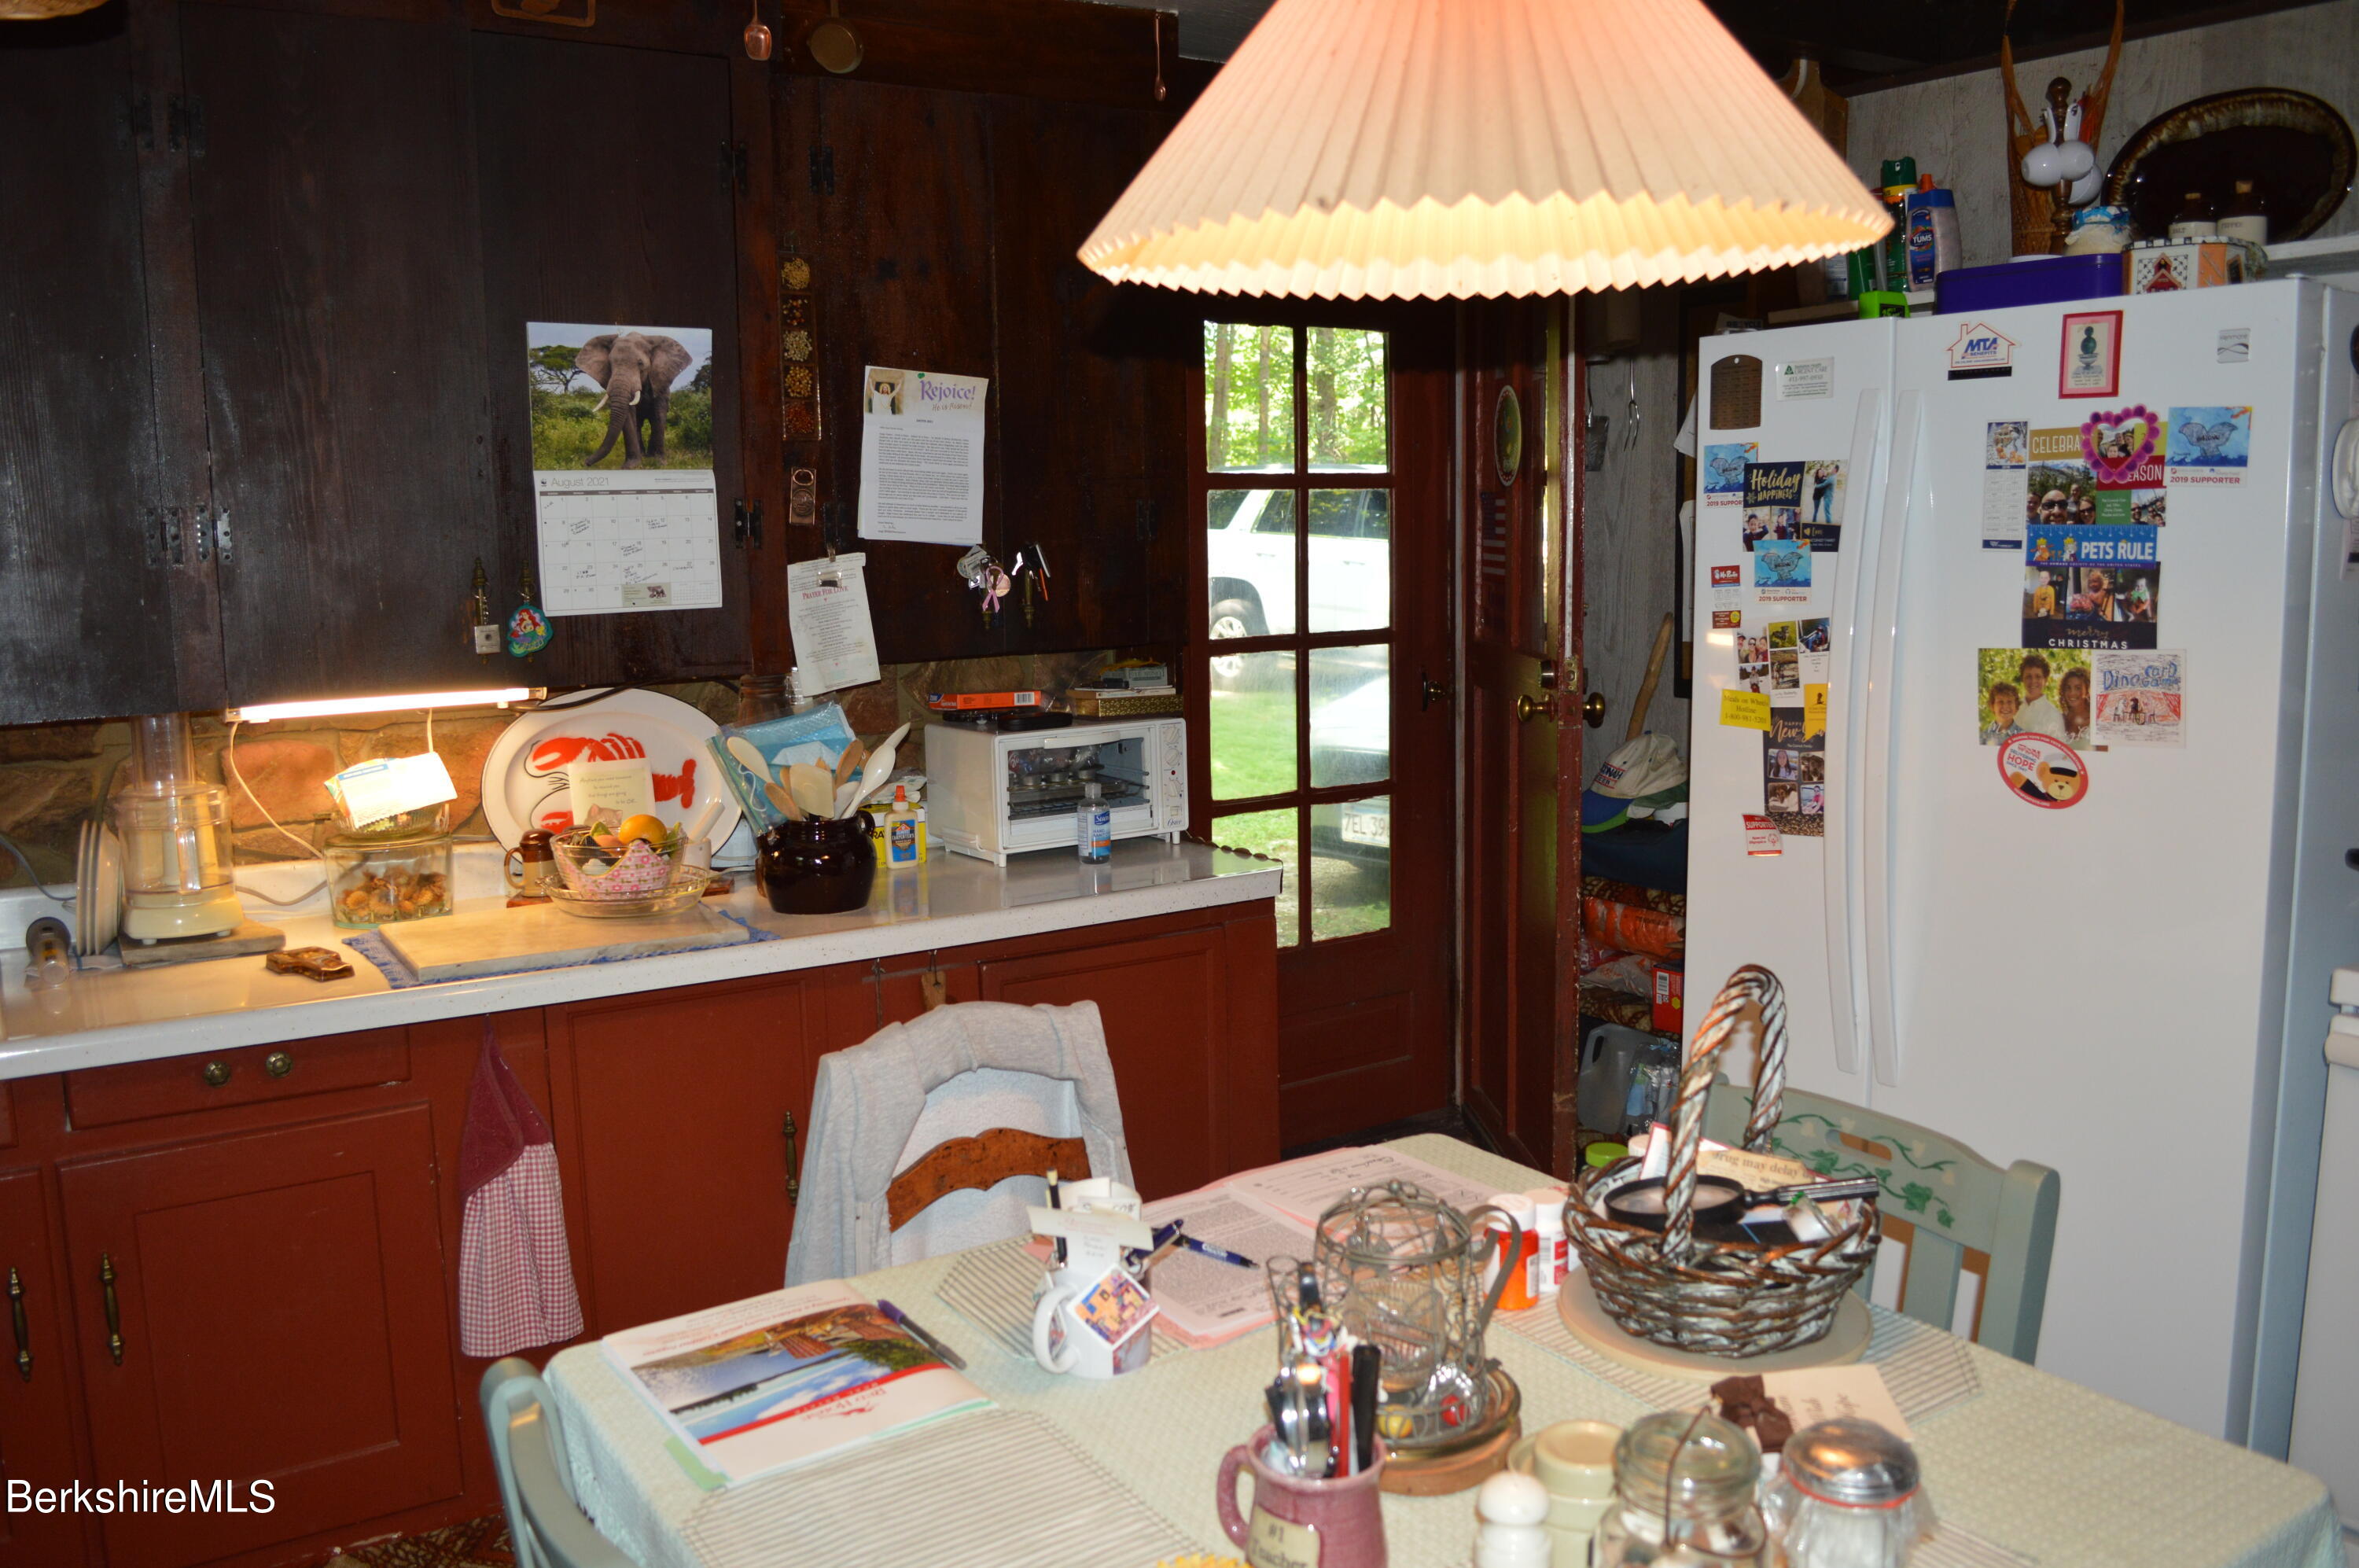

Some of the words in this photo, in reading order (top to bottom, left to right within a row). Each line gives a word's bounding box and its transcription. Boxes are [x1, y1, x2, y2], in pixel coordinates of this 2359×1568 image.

[1912, 234, 1932, 244] TUMS
[1963, 337, 1999, 355] MTA
[920, 380, 976, 402] Rejoice!
[2032, 435, 2081, 454] CELEBRA
[551, 478, 583, 488] August
[587, 477, 609, 486] 2021
[1750, 468, 1801, 492] Holiday
[1757, 489, 1793, 502] HAPPINESS
[2081, 542, 2114, 560] PETS
[2118, 542, 2155, 561] RULE
[802, 591, 822, 599] PRAYER
[2048, 639, 2129, 650] CHRISTMAS
[2103, 670, 2140, 690] Dino
[1750, 698, 1769, 706] Wheels
[1769, 720, 1798, 742] New
[2007, 753, 2035, 771] HOPE
[1345, 813, 1366, 834] 7EL
[1371, 816, 1389, 837] 39
[1743, 1159, 1766, 1173] may
[1770, 1162, 1799, 1178] delay
